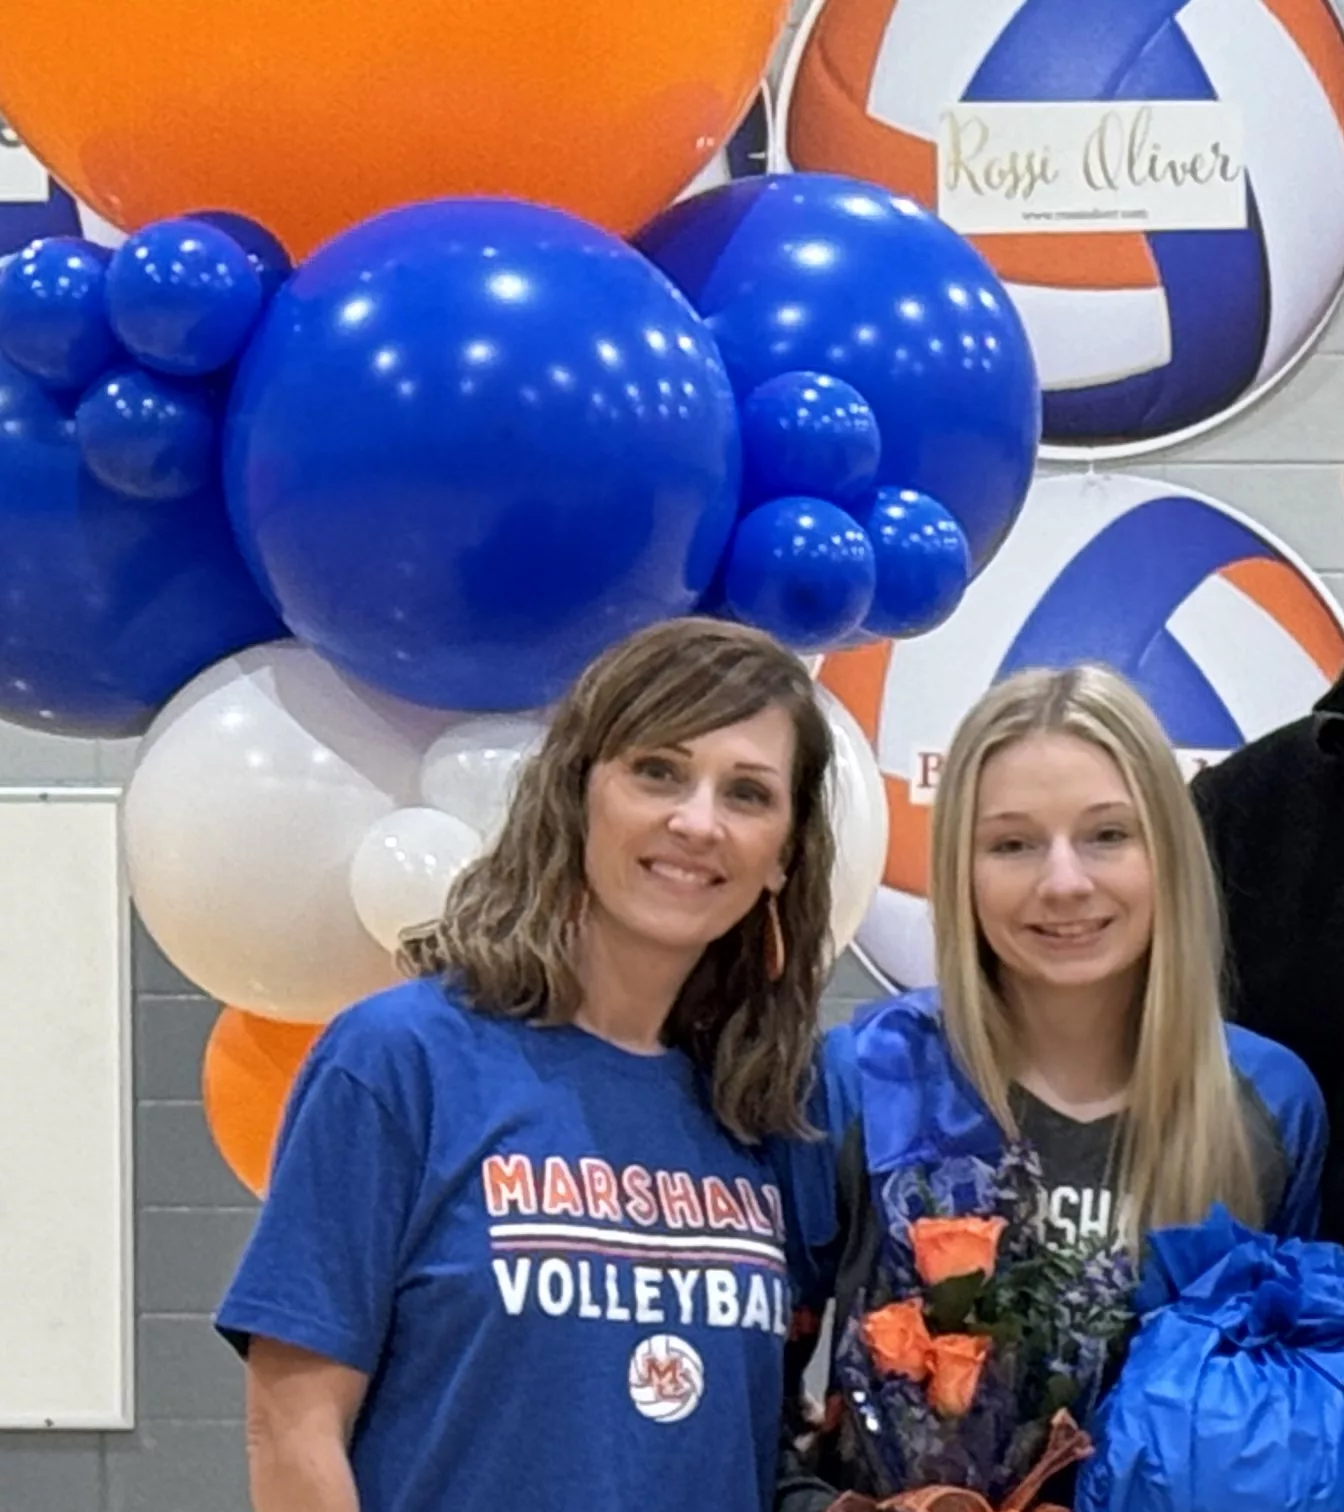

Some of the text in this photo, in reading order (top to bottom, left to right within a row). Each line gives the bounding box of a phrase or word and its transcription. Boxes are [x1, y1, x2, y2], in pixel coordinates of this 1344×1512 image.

[940, 104, 1244, 201] Rossi Oliver
[482, 1154, 787, 1244] MARSHALL
[492, 1257, 793, 1336] VOLLEYBAL
